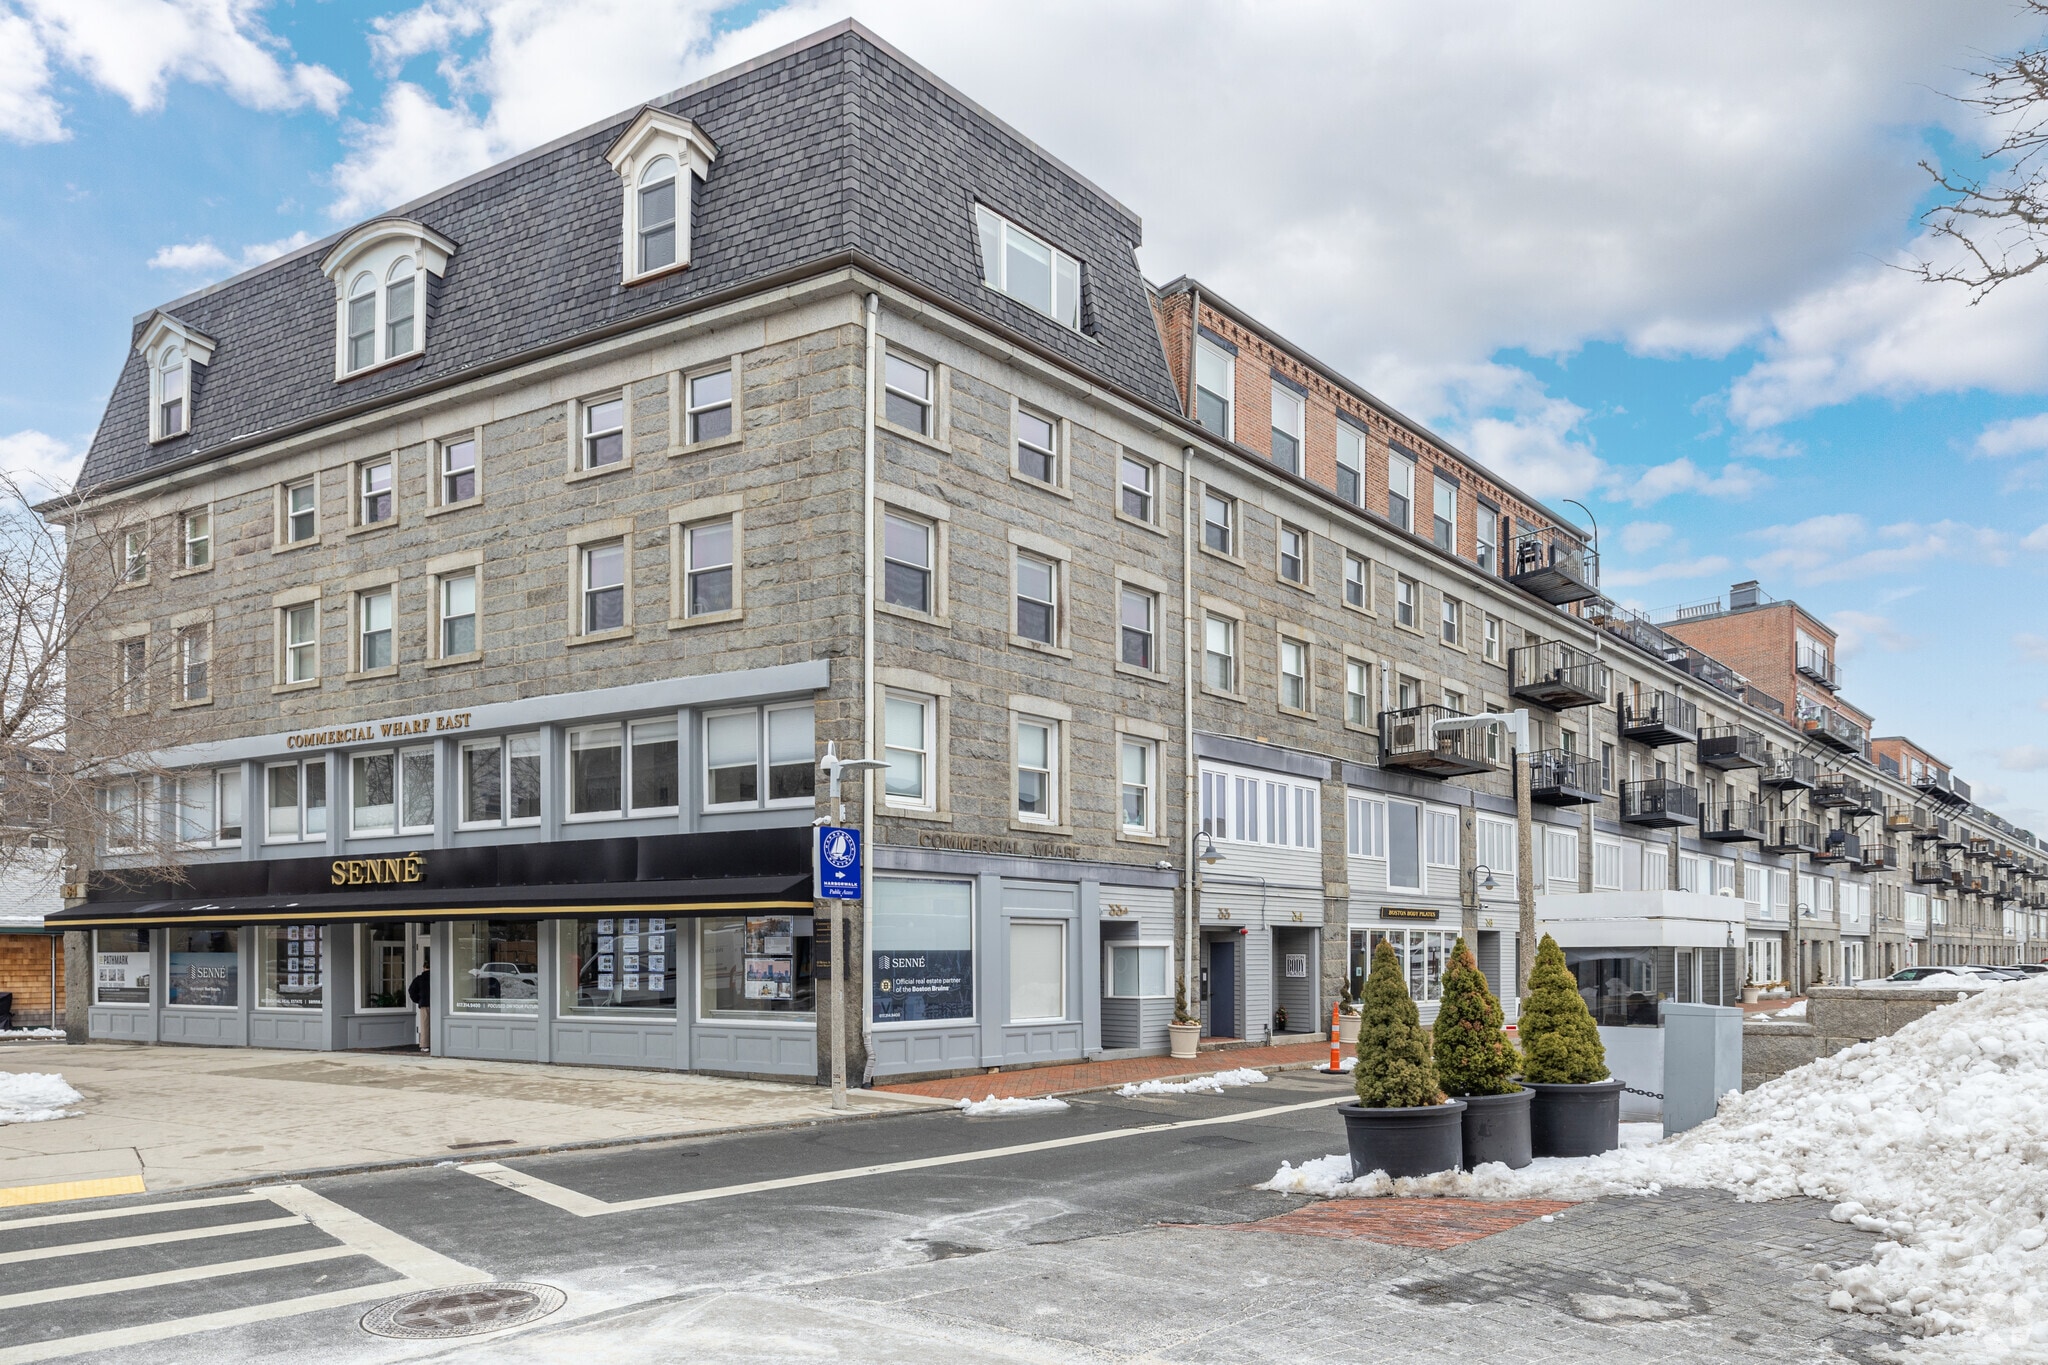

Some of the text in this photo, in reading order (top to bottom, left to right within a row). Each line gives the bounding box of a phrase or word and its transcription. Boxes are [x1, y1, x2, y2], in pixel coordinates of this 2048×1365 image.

[286, 713, 471, 749] COMMERCIAL WHARF EAST
[919, 832, 1080, 858] COMMERCIAL WHARF
[331, 852, 424, 886] SENNÉ
[1217, 908, 1231, 920] 33
[104, 955, 128, 965] PATHMARK
[892, 956, 926, 968] SENNÉ
[1287, 960, 1304, 972] BODY
[197, 965, 226, 978] SENNÉ
